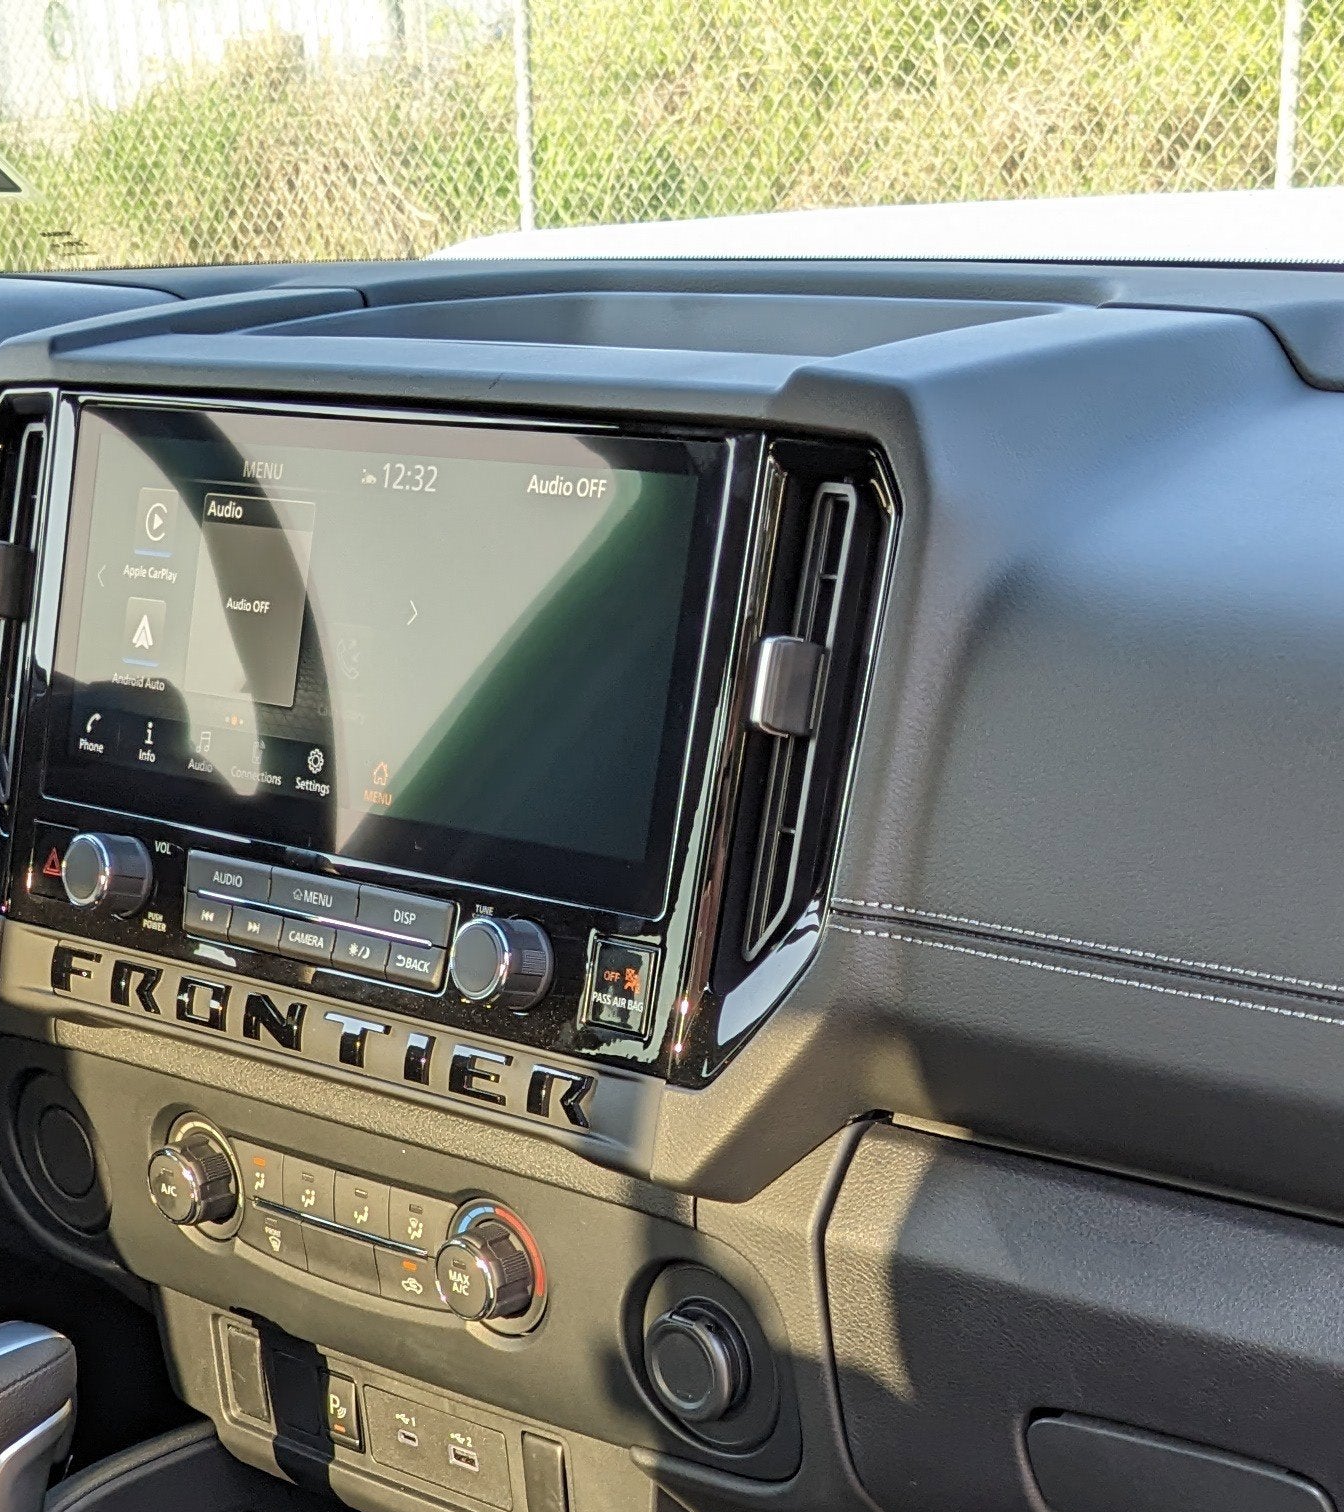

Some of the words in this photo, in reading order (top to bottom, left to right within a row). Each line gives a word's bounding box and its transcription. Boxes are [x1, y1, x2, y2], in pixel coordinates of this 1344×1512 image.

[243, 460, 284, 481] MENU
[382, 462, 438, 493] 12:32
[526, 474, 573, 497] Audio
[576, 477, 607, 499] OFF
[207, 500, 243, 520] Audio
[123, 564, 147, 580] Apple
[148, 567, 178, 584] CarPlay
[226, 597, 252, 613] Audio
[252, 599, 271, 614] OFF
[111, 672, 144, 689] Android
[145, 677, 165, 692] Auto
[78, 737, 104, 755] Phone
[138, 748, 157, 763] Info
[187, 757, 213, 774] Audio
[230, 765, 283, 787] Connections
[294, 776, 331, 798] Settings
[364, 790, 393, 808] MENU
[154, 840, 172, 856] VOL
[212, 870, 244, 888] AUDIO
[303, 889, 334, 909] MENU
[147, 911, 164, 922] PUSH
[393, 909, 417, 926] DISP
[474, 903, 495, 916] TUNE
[142, 918, 167, 933] POWER
[288, 930, 325, 949] CAMERA
[405, 957, 432, 974] BACK
[603, 970, 622, 982] OFF
[592, 991, 612, 1006] PASS
[612, 996, 627, 1009] AIR
[627, 999, 644, 1013] BAG
[53, 938, 599, 1136] FRONTIER
[160, 1182, 178, 1198] A/C
[448, 1269, 471, 1286] MAX
[452, 1281, 470, 1296] A/C
